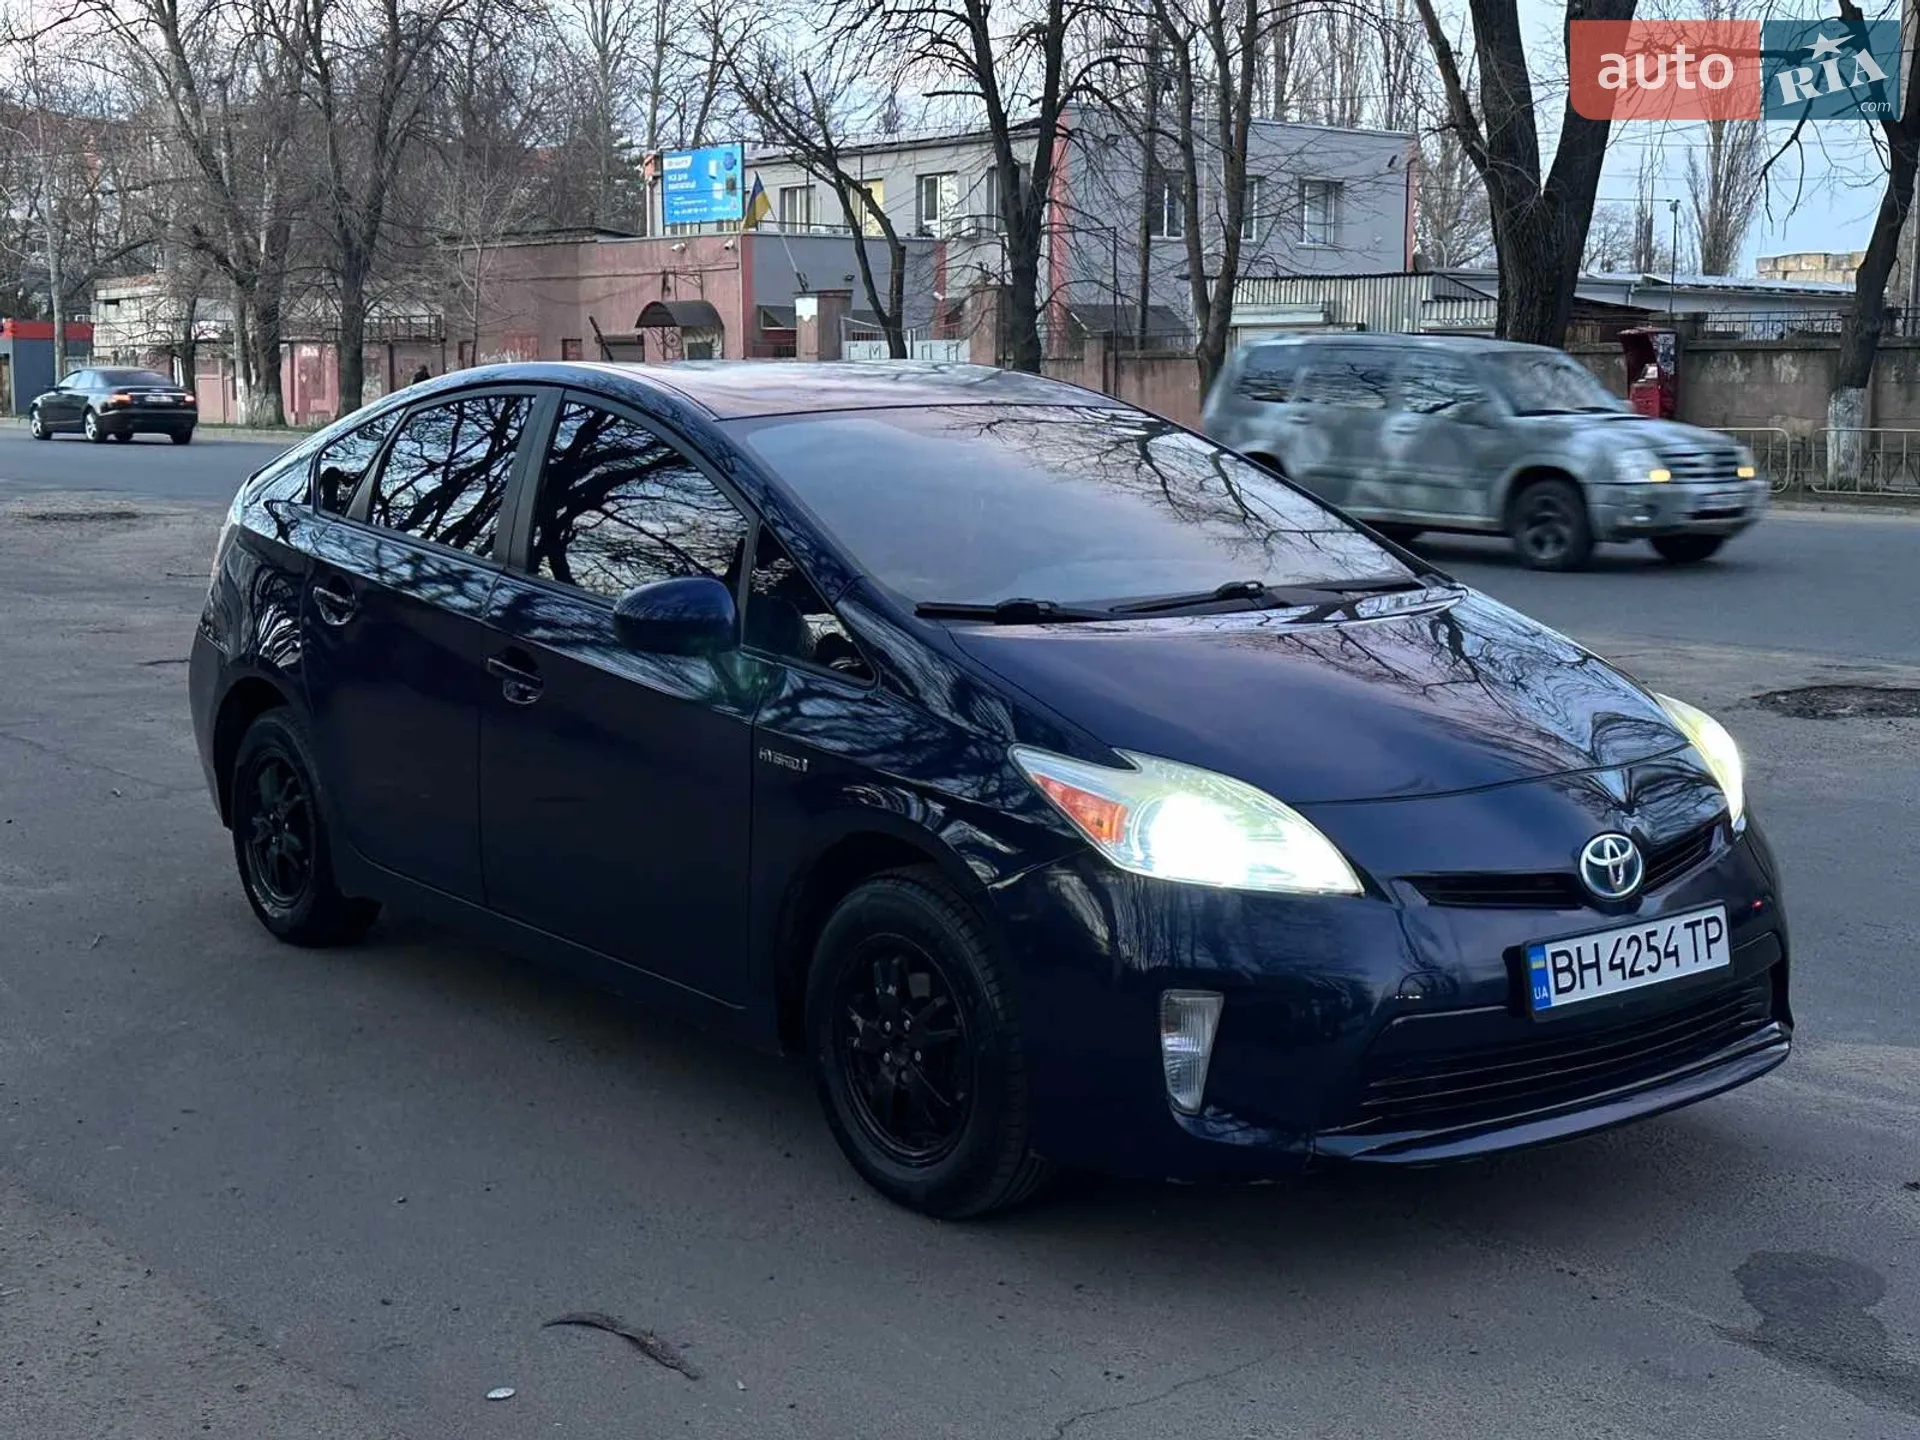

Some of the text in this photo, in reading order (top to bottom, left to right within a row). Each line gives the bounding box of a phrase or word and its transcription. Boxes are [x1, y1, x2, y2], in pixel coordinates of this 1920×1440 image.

[1551, 915, 1724, 996] BH 4254 TP
[1534, 985, 1548, 1000] UA
